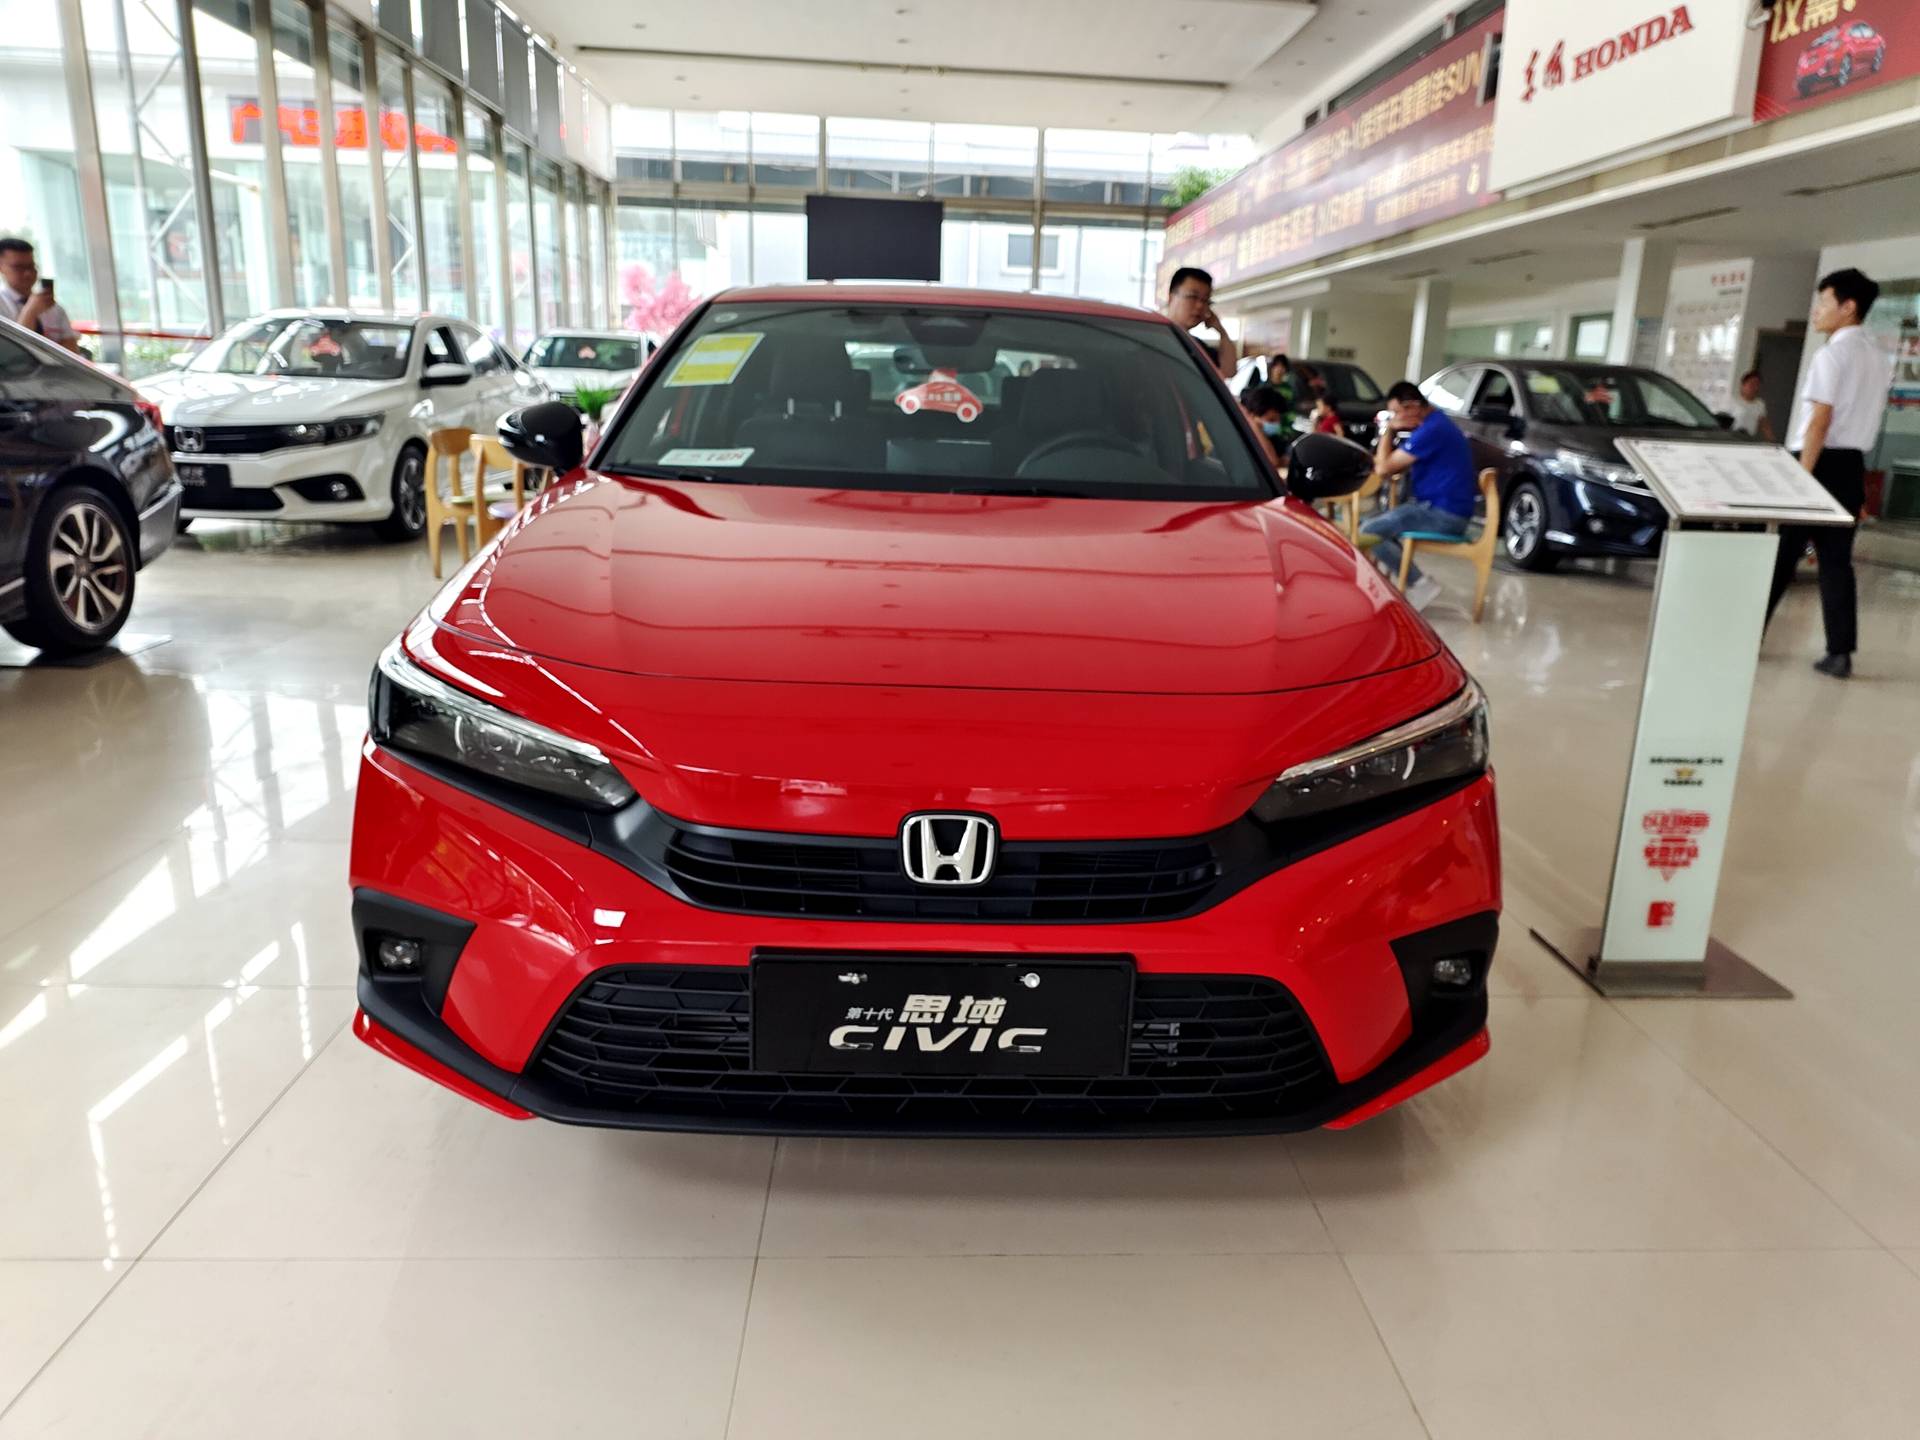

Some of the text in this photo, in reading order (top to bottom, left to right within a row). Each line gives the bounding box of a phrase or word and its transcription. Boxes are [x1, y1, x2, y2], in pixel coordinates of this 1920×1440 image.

[1572, 4, 1695, 82] HONDA
[845, 994, 1007, 1024] 第十代 思域
[828, 1024, 1049, 1053] CIVIC
